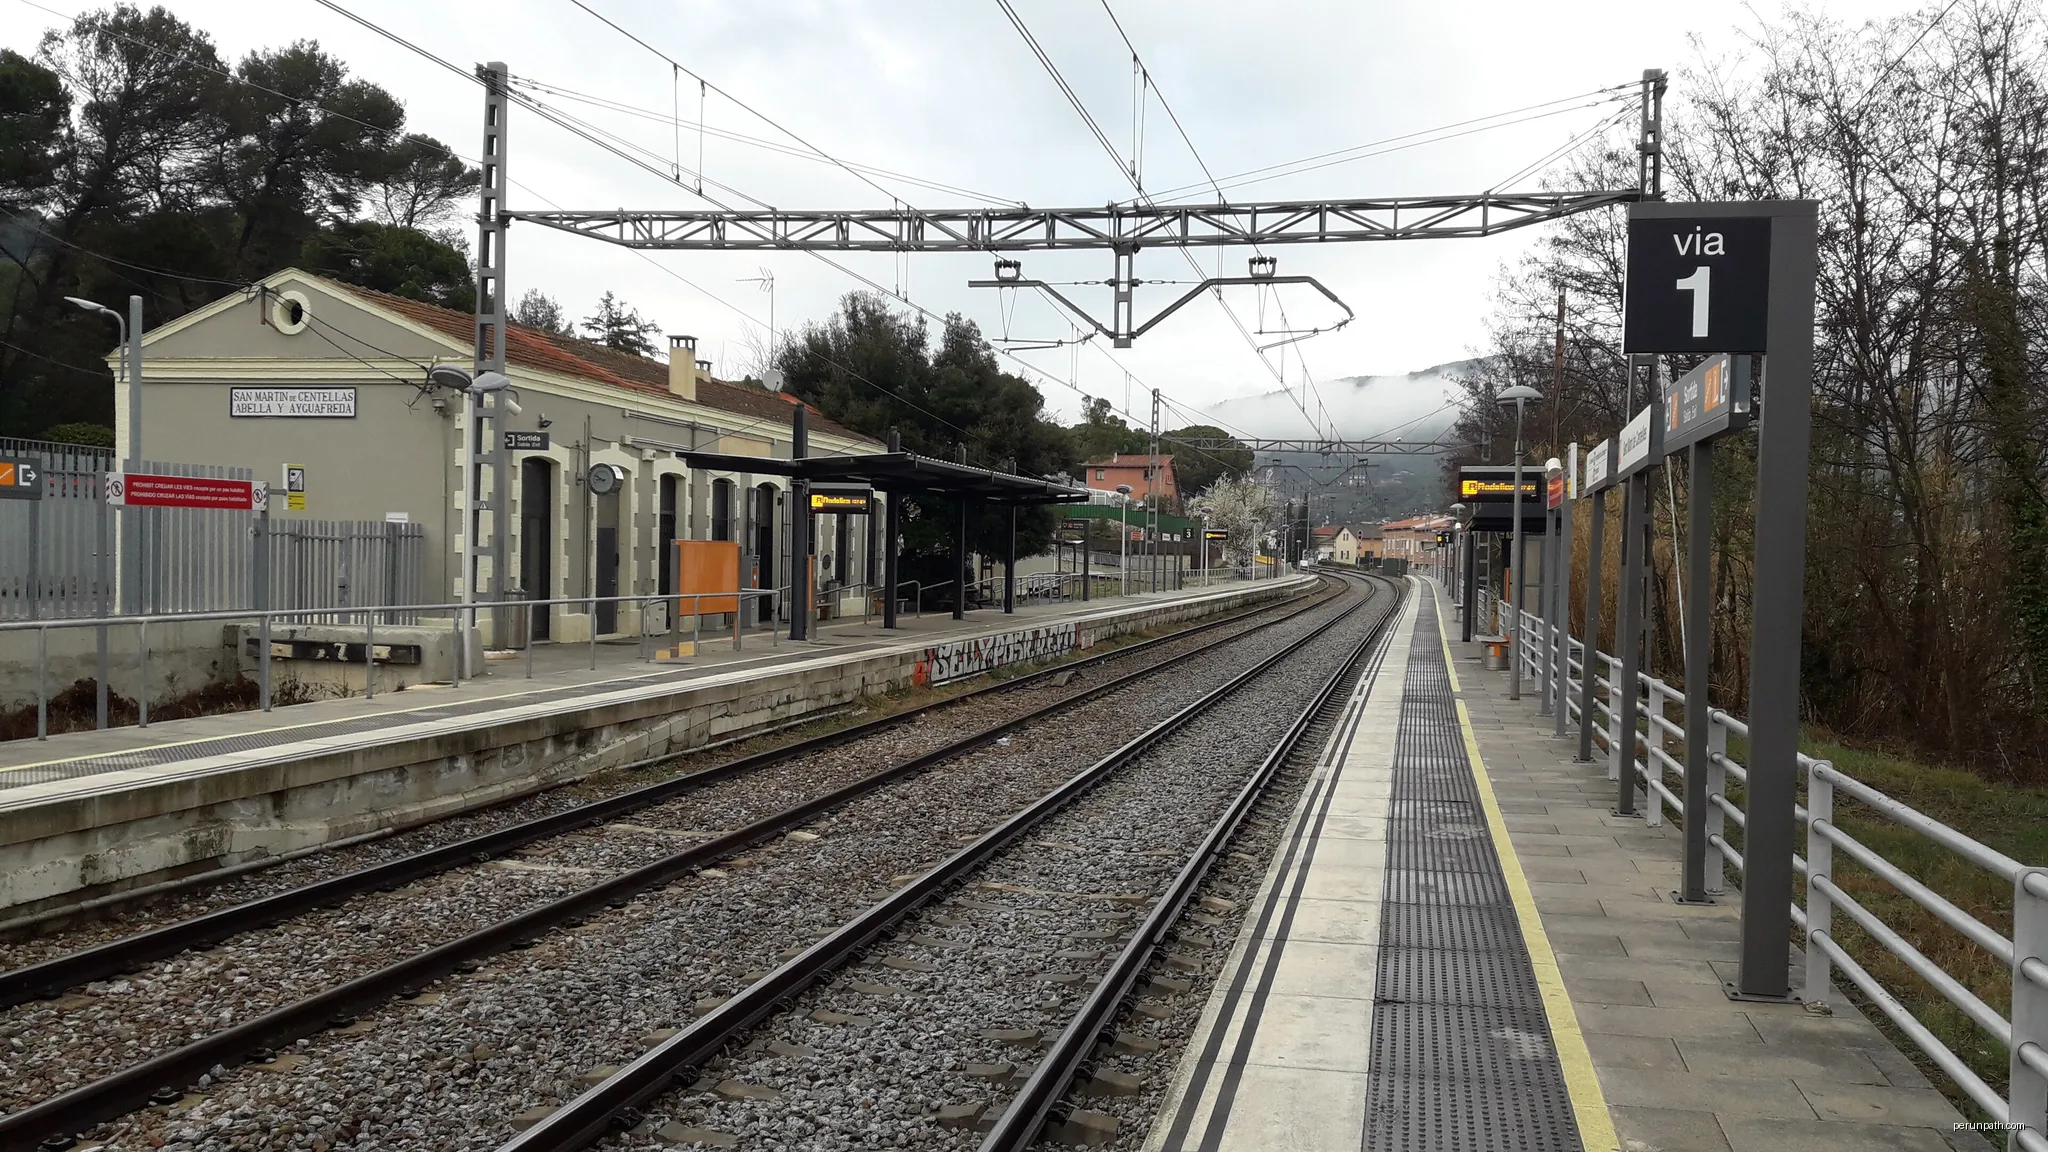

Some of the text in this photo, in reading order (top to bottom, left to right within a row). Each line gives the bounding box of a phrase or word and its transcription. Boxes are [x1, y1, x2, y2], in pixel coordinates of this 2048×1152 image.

[1673, 225, 1725, 256] via
[1676, 265, 1710, 338] 1
[233, 391, 252, 402] SAN
[254, 391, 288, 402] MARTIN
[297, 391, 354, 402] CENTELLAS
[234, 403, 352, 414] ABELLA Y AYGUAFREDA
[516, 434, 541, 442] Sortida
